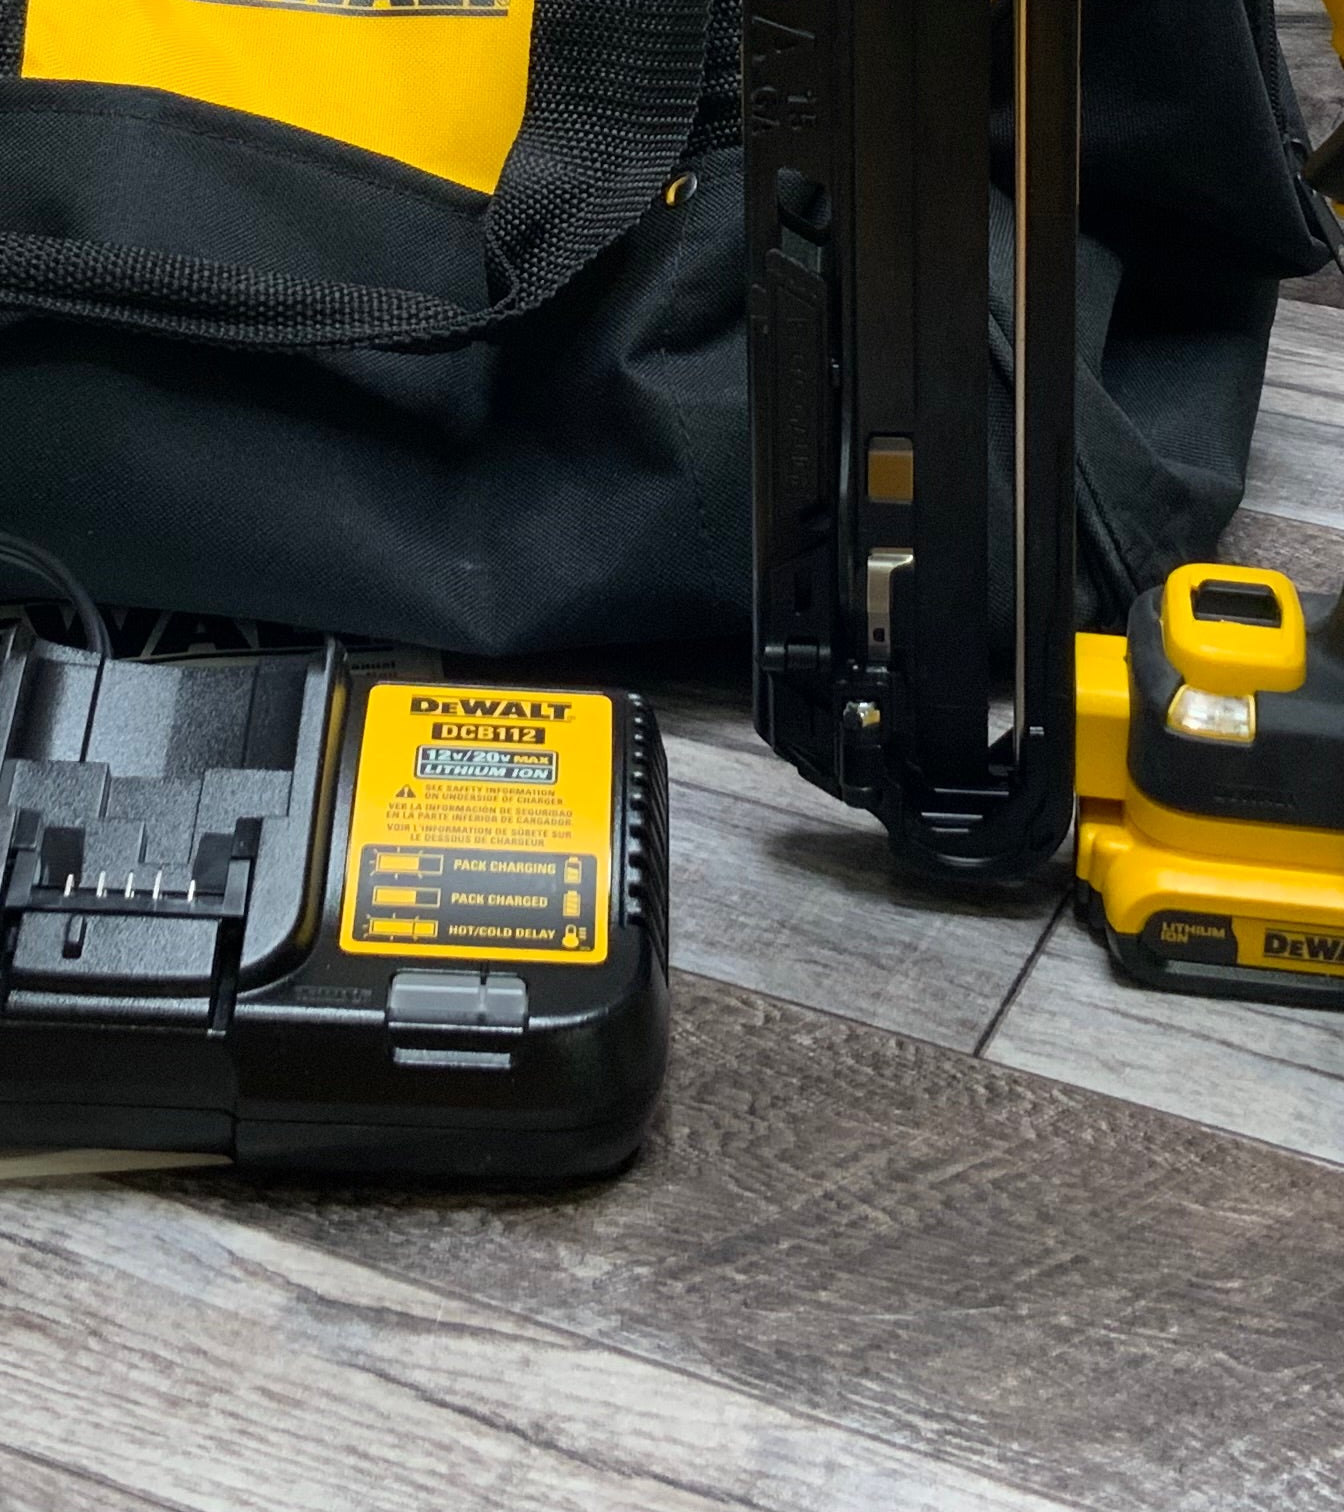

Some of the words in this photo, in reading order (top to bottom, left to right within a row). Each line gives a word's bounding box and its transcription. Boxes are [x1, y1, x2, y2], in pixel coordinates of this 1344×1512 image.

[441, 724, 536, 742] DCB112
[514, 755, 549, 764] MAX
[424, 764, 506, 777] LITHIUM
[512, 768, 549, 780] ION
[446, 784, 482, 793] SAFETY
[486, 787, 556, 796] INFORMATION
[442, 793, 498, 803] UNDERSIDE
[502, 795, 513, 803] OF
[403, 811, 415, 819] LA
[418, 812, 448, 821] PARTE
[452, 814, 497, 823] INFERIOR
[500, 806, 511, 814] DE
[515, 808, 573, 818] SEGURIDAD
[387, 823, 410, 832] VOIR
[552, 830, 572, 839] SUR
[424, 834, 472, 843] DESSOUS
[490, 837, 545, 847] CHARGEUR
[454, 859, 487, 872] PACK
[490, 860, 556, 875] CHARGING
[451, 892, 485, 905] PACK
[488, 894, 548, 908] CHARGED
[448, 925, 513, 938] HOT/COLD
[516, 928, 556, 940] DELAY
[1162, 922, 1226, 938] LITHIUM
[1161, 932, 1189, 944] ION
